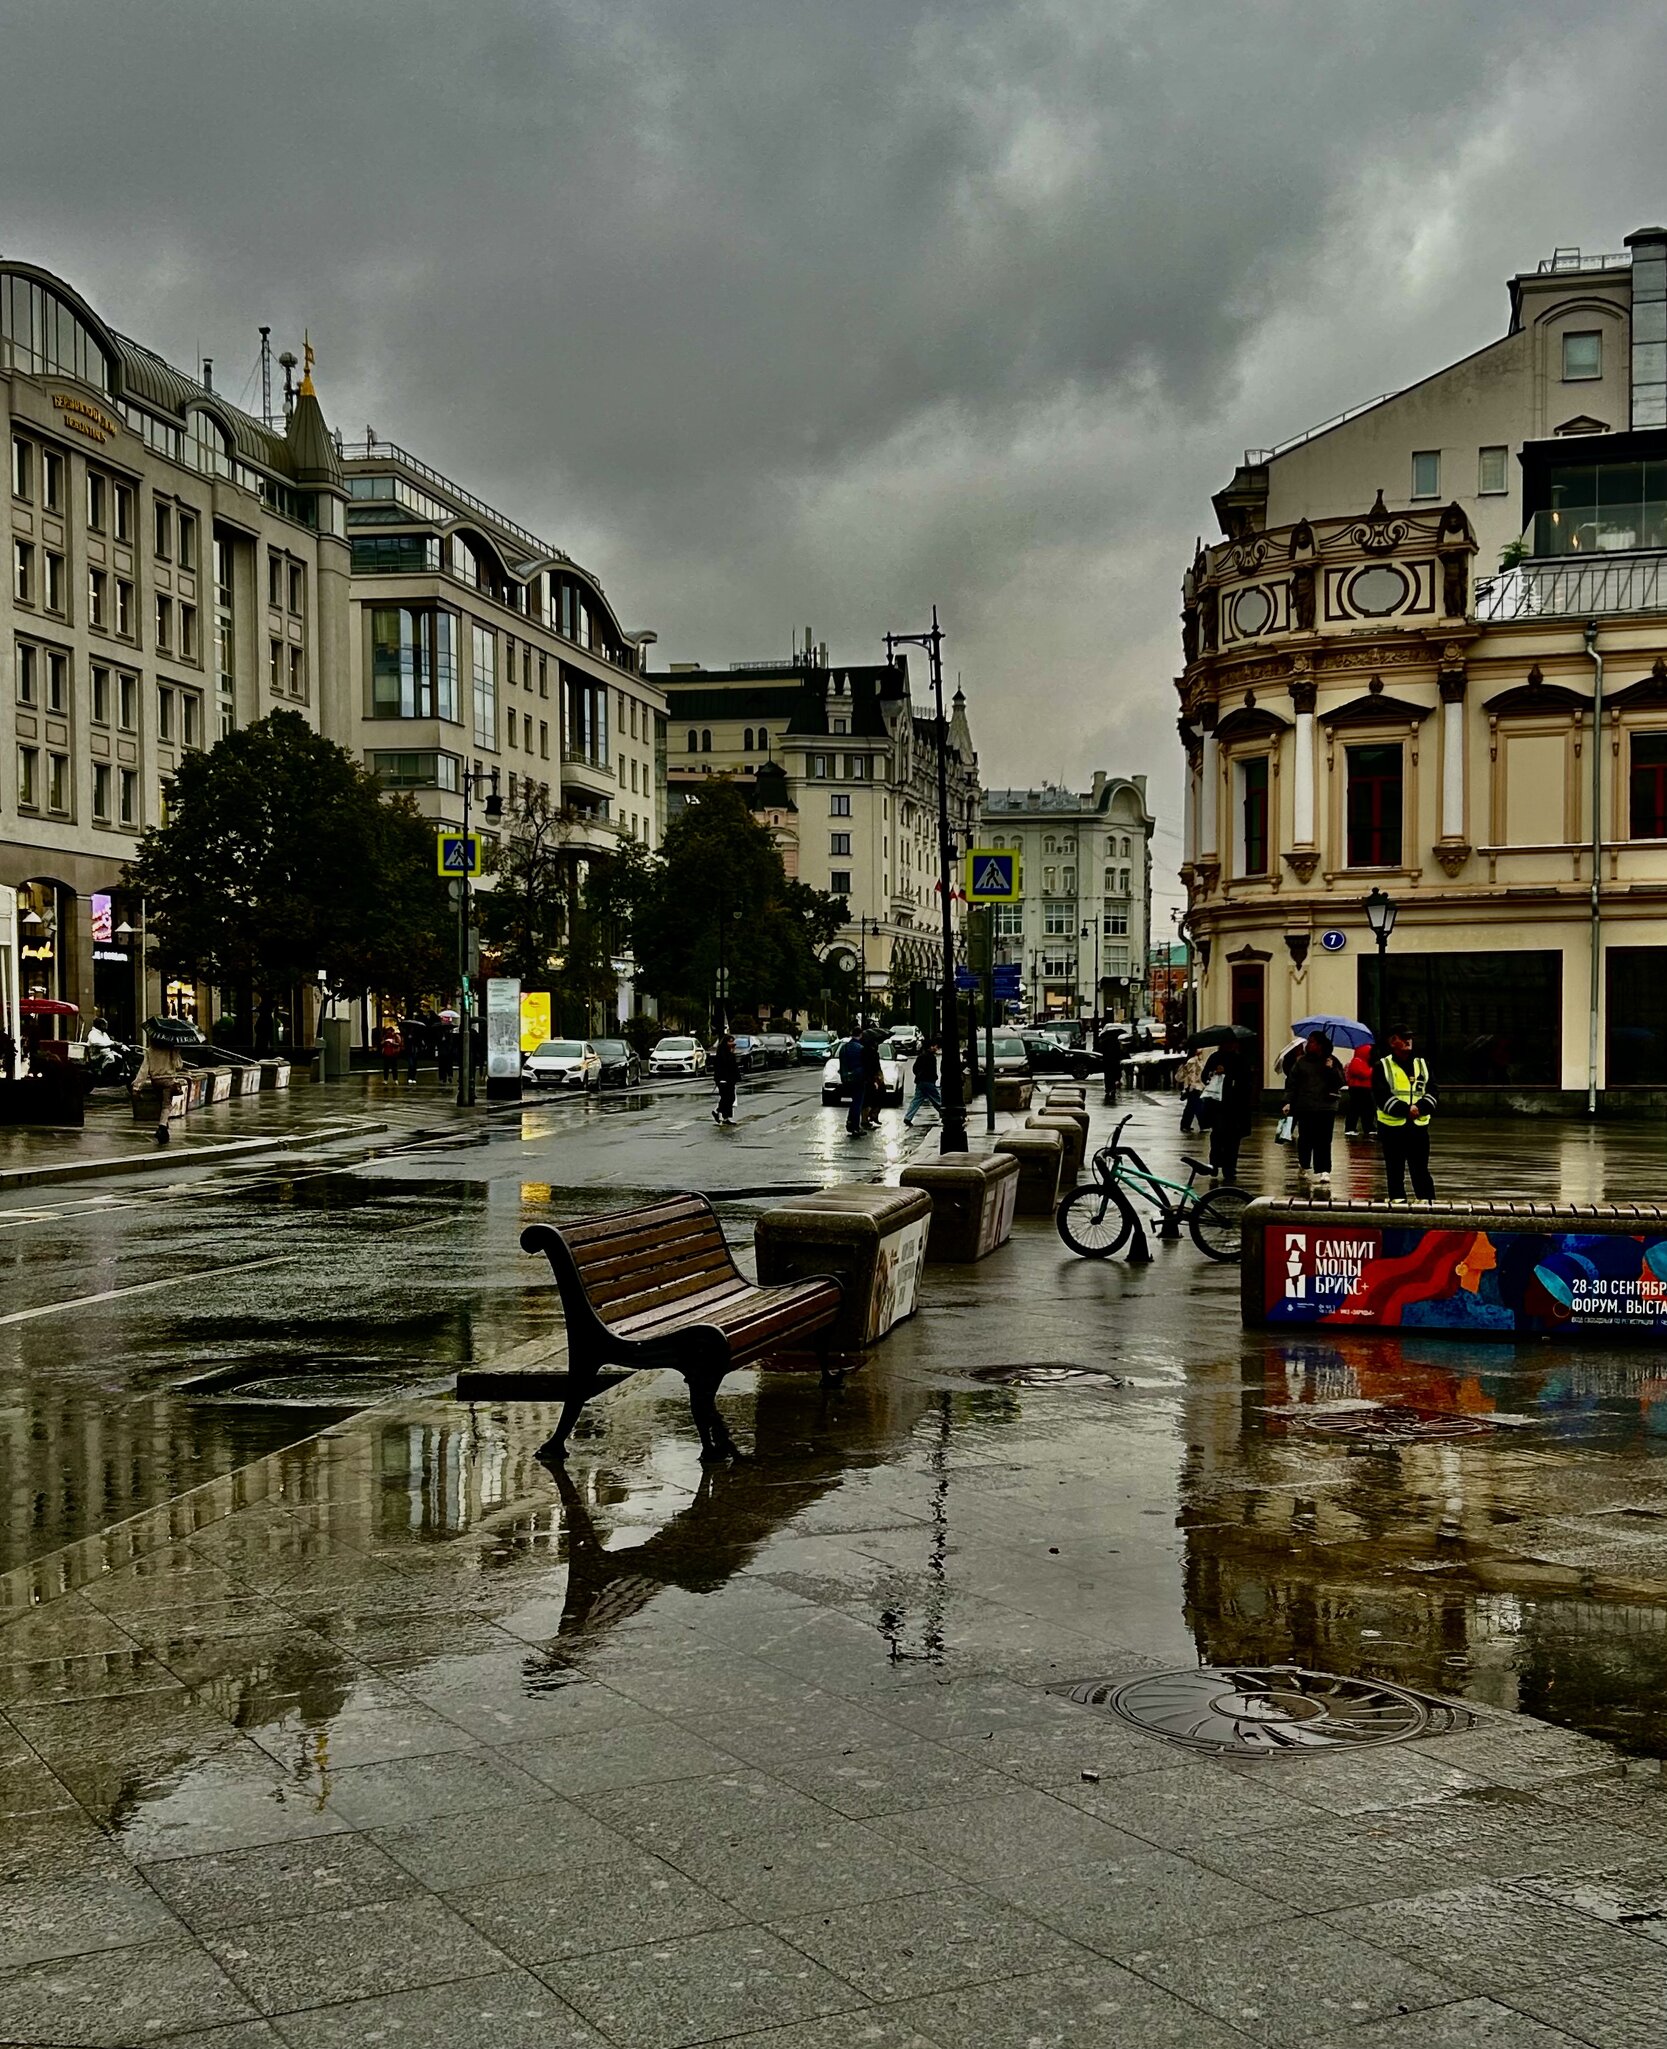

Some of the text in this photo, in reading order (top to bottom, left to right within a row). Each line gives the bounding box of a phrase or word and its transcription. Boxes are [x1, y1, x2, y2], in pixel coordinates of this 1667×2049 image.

[1329, 934, 1337, 945] 7
[1315, 1240, 1376, 1259] САММИТ
[1315, 1258, 1362, 1277] МОДЫ
[1315, 1276, 1369, 1295] БРИКС+
[1572, 1279, 1667, 1296] 28-30 СЕНТЯБР
[1571, 1297, 1622, 1313] ФОРУМ.
